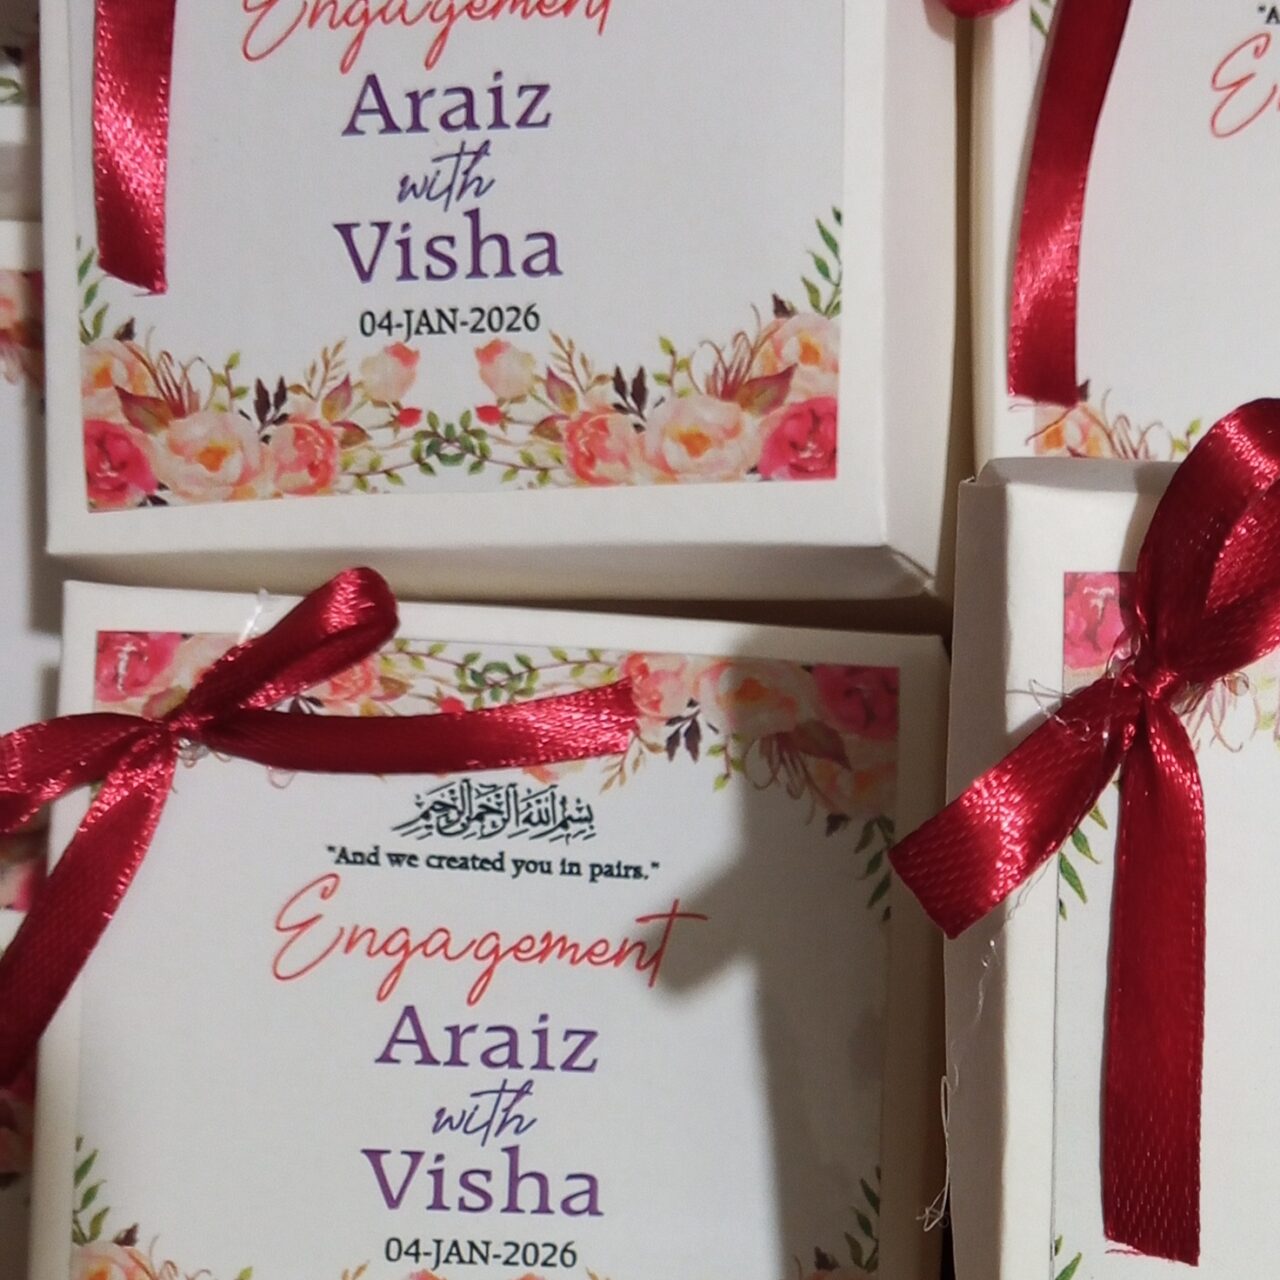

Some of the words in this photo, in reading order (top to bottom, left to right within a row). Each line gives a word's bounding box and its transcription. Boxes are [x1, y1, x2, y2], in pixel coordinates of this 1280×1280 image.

[341, 70, 552, 136] Araiz
[397, 139, 495, 212] with
[332, 207, 563, 284] Visha
[359, 303, 540, 343] 04-JAN-2026
[327, 846, 380, 867] "And
[386, 852, 419, 868] we
[426, 851, 505, 872] created
[511, 858, 553, 879] you
[560, 857, 582, 876] in
[589, 860, 660, 882] pairs."
[271, 872, 709, 1007] Engagement
[374, 1005, 599, 1074] Araiz
[431, 1078, 537, 1148] with
[361, 1144, 604, 1217] Visha
[384, 1236, 577, 1271] 04-JAN-2026
